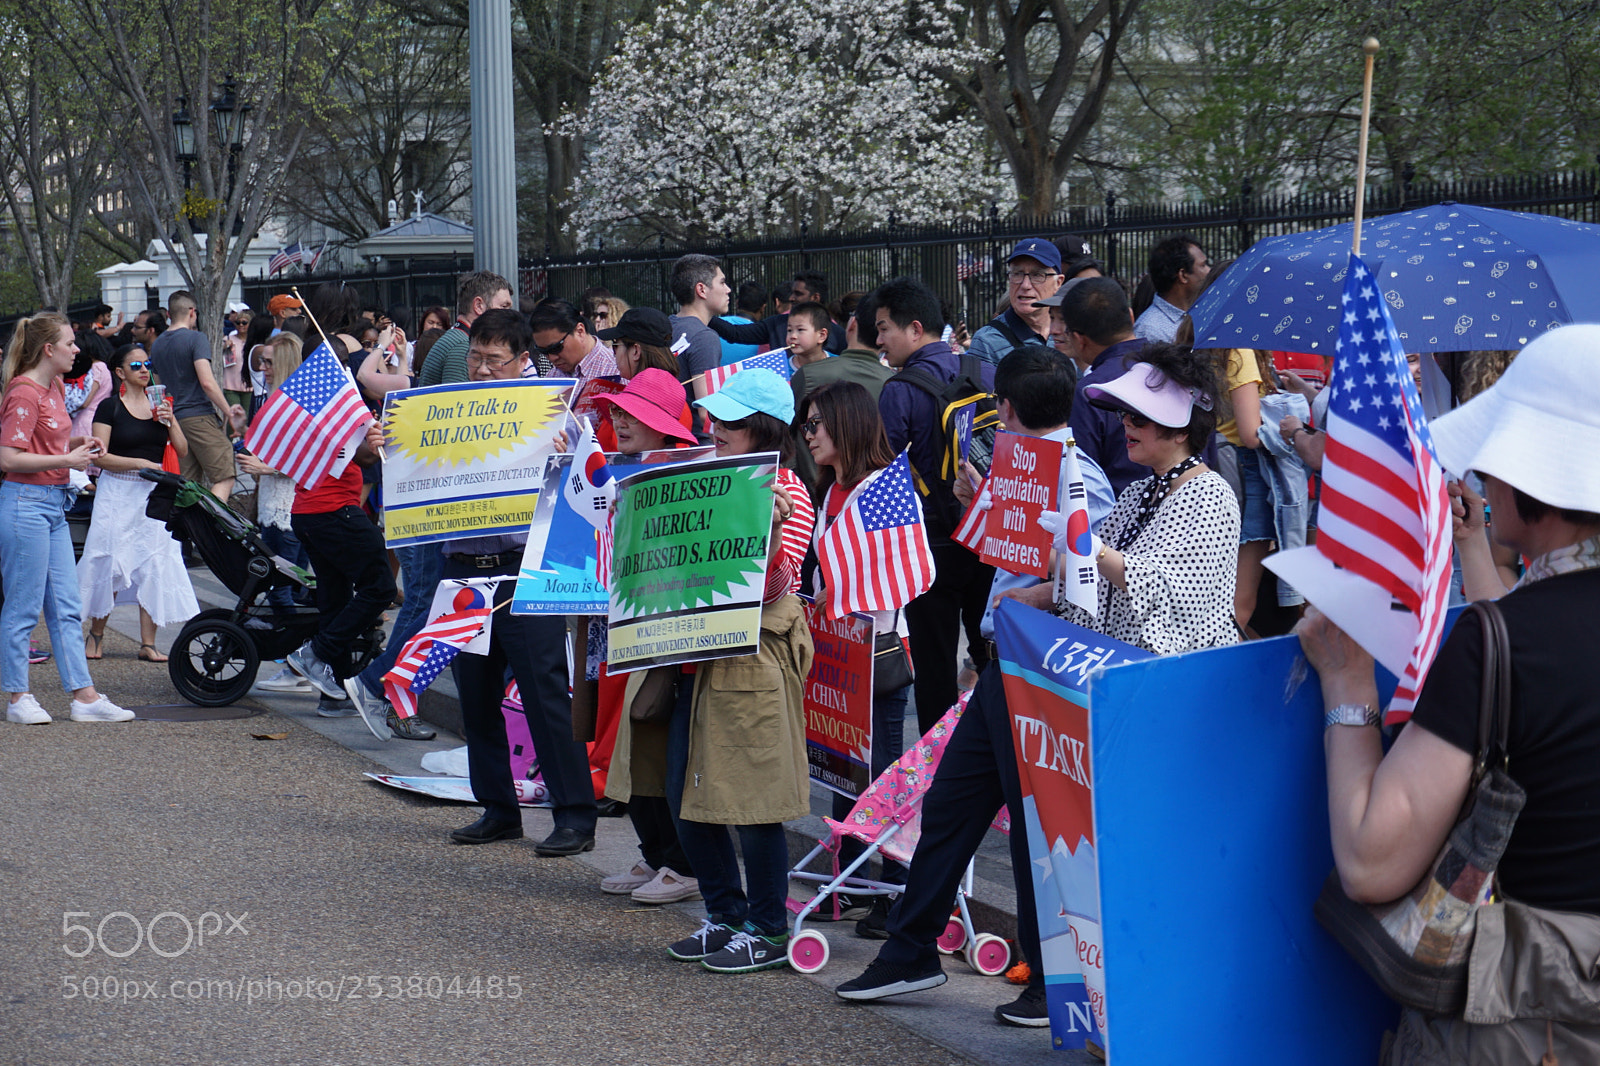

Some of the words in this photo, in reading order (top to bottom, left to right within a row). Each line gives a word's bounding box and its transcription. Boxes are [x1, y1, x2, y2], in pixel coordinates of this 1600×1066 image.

[425, 401, 464, 422] Don't
[467, 398, 500, 418] Talk
[502, 399, 518, 415] to
[419, 429, 450, 447] KIM
[450, 421, 523, 443] JONG-UN
[1011, 443, 1037, 475] Stop
[396, 483, 407, 493] HE
[407, 481, 415, 492] IS
[415, 479, 431, 491] THE
[431, 476, 453, 489] MOST
[453, 470, 498, 486] OPRESSIVE
[498, 466, 540, 481] DICTATOR
[633, 486, 658, 512] GOD
[659, 474, 732, 505] BLESSED
[992, 475, 1050, 510] negotiating
[411, 520, 446, 534] PATRIOTIC
[446, 515, 487, 529] MOVEMENT
[488, 510, 535, 524] ASSOCIATIO
[641, 508, 713, 541] AMERICA!
[1002, 505, 1027, 533] with
[614, 555, 632, 580] GOD
[632, 544, 688, 575] BLESSED
[689, 542, 703, 565] S.
[706, 535, 767, 563] KOREA
[983, 535, 1042, 568] murderers.
[544, 578, 579, 593] Moon
[582, 578, 592, 593] is
[625, 641, 656, 658] PATRIOTIC
[656, 636, 695, 654] MOVEMENT
[695, 631, 748, 648] ASSOCIATION
[829, 617, 866, 645] Nukes!
[811, 632, 833, 659] oon
[818, 661, 841, 689] KIM
[812, 682, 848, 715] CHINA
[809, 709, 865, 749] INNOCENT
[822, 769, 857, 794] ASSOCIATION
